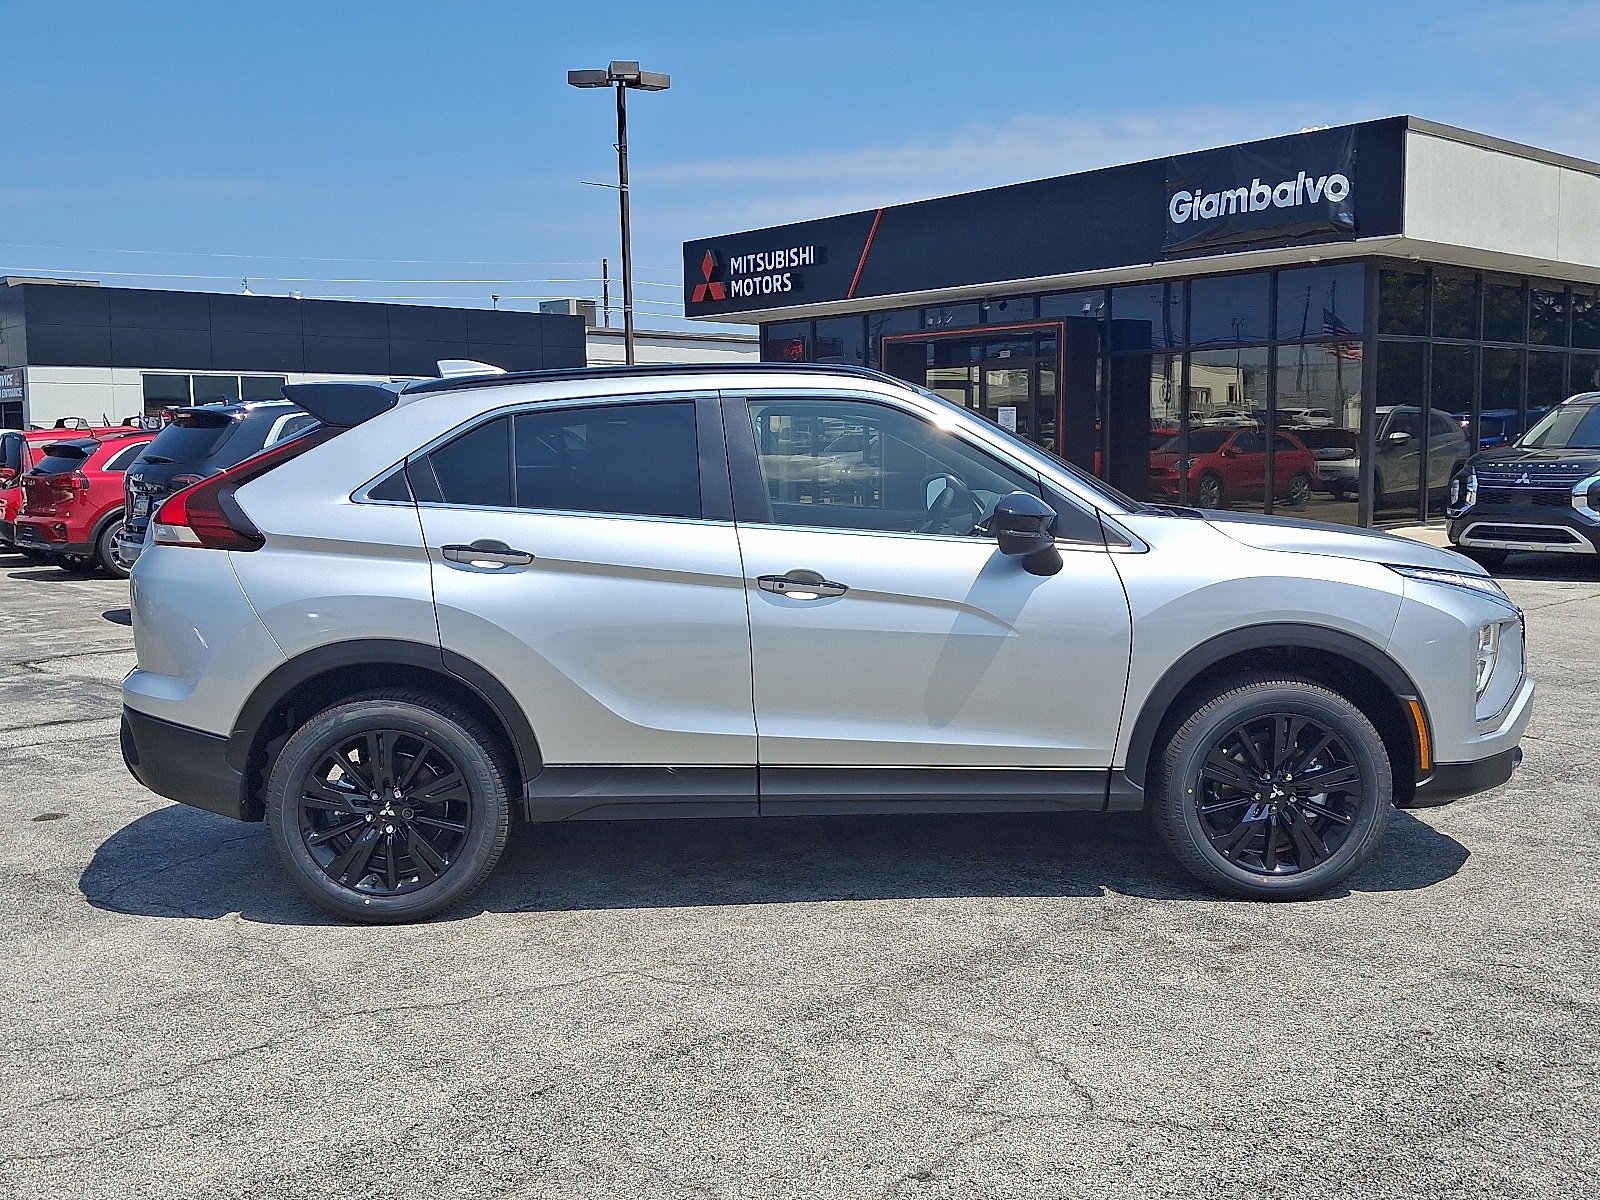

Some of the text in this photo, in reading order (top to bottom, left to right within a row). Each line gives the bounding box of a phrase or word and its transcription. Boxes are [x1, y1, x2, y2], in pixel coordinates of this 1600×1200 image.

[1169, 171, 1350, 224] Giambalvo
[730, 246, 814, 275] MITSUBISHI
[731, 273, 792, 297] MOTORS
